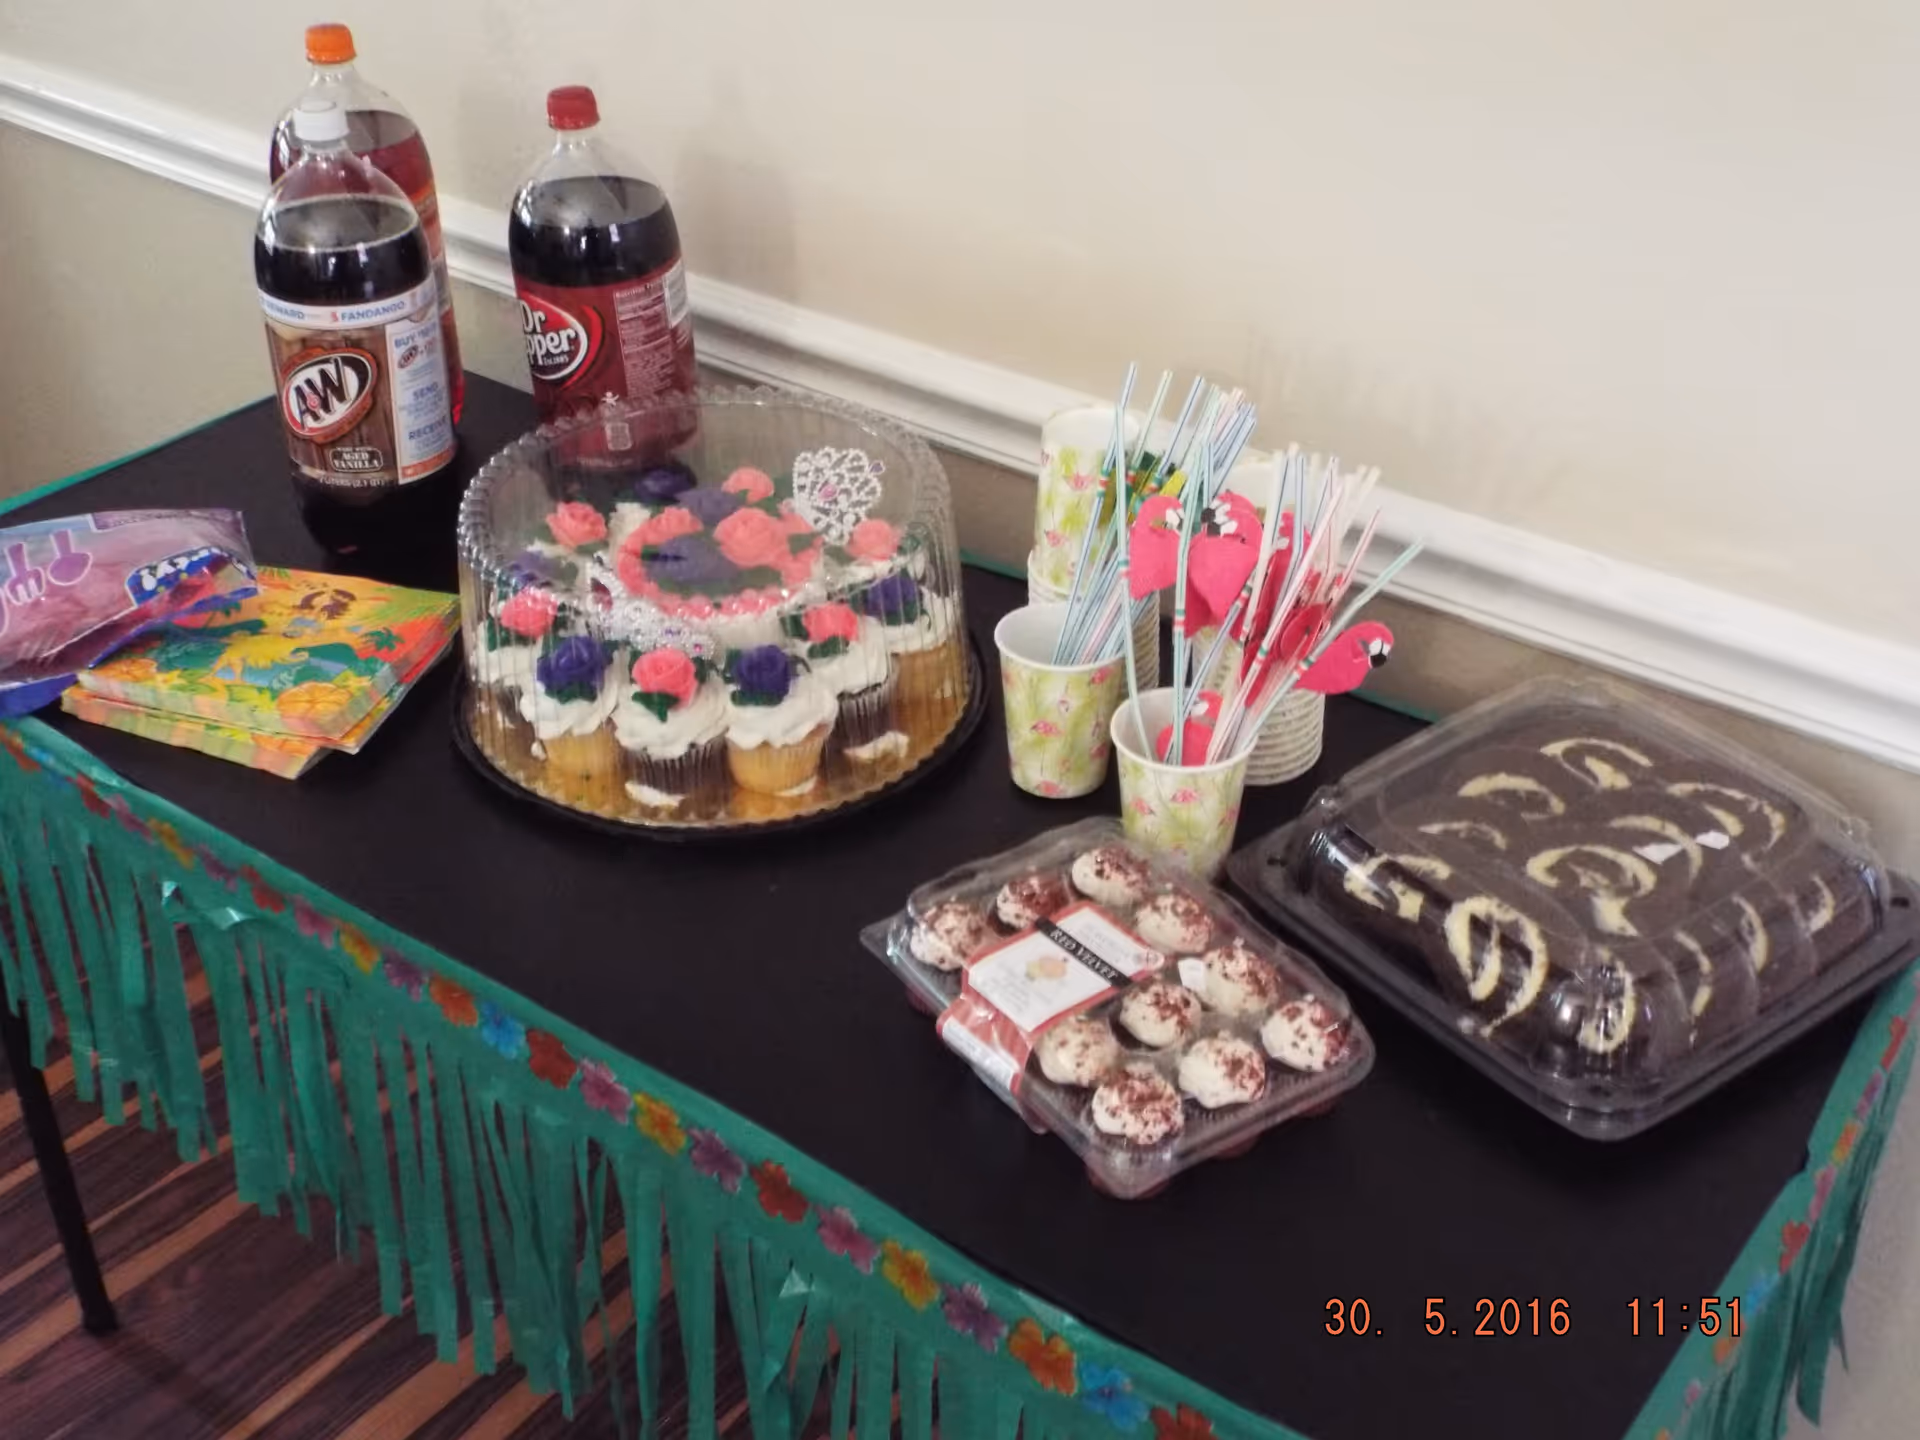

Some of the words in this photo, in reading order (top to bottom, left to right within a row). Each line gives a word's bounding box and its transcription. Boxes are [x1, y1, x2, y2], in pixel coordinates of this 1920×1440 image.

[341, 300, 405, 321] FANDANGO
[520, 300, 546, 333] Dr
[332, 459, 379, 469] VANILLA
